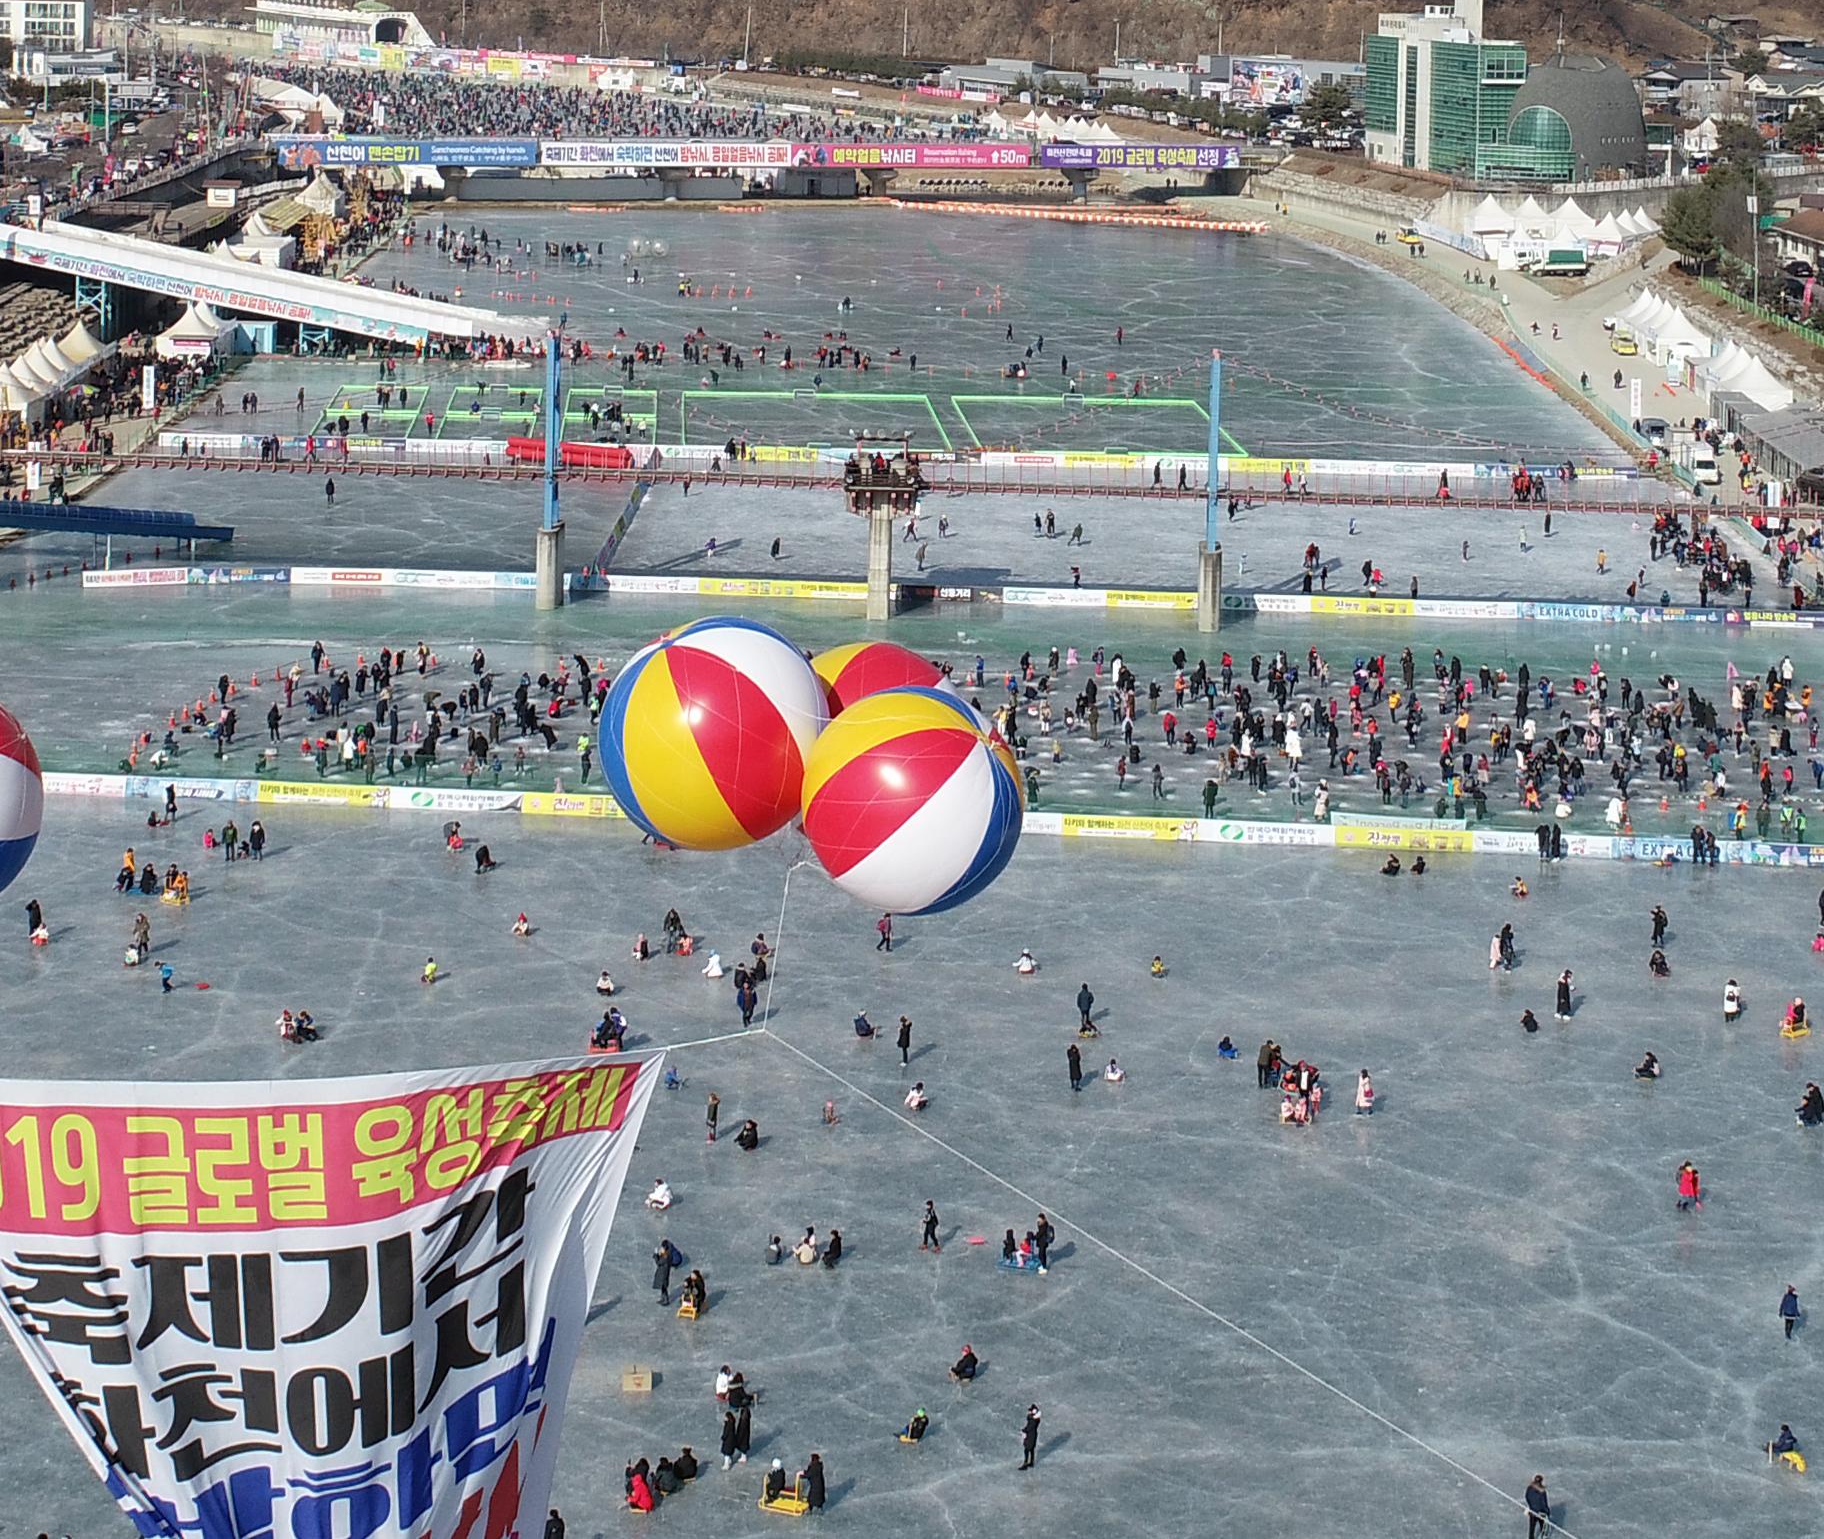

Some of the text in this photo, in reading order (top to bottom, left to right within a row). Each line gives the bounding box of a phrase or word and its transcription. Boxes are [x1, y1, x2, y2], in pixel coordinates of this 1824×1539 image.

[545, 146, 577, 162] 축제기간
[579, 146, 615, 162] 화천에서
[616, 146, 653, 162] 숙박하면
[654, 146, 678, 162] 산천어
[1000, 149, 1026, 164] 50m
[1096, 147, 1124, 164] 2019
[1126, 148, 1154, 165] 글로벌
[1157, 148, 1196, 165] 육성축제
[1197, 149, 1219, 166] 선정
[1539, 606, 1598, 618] EXTRA COLD
[122, 1112, 329, 1225] 글로벌
[352, 1066, 628, 1203] 육성축제
[1, 1165, 536, 1365] 축제기간
